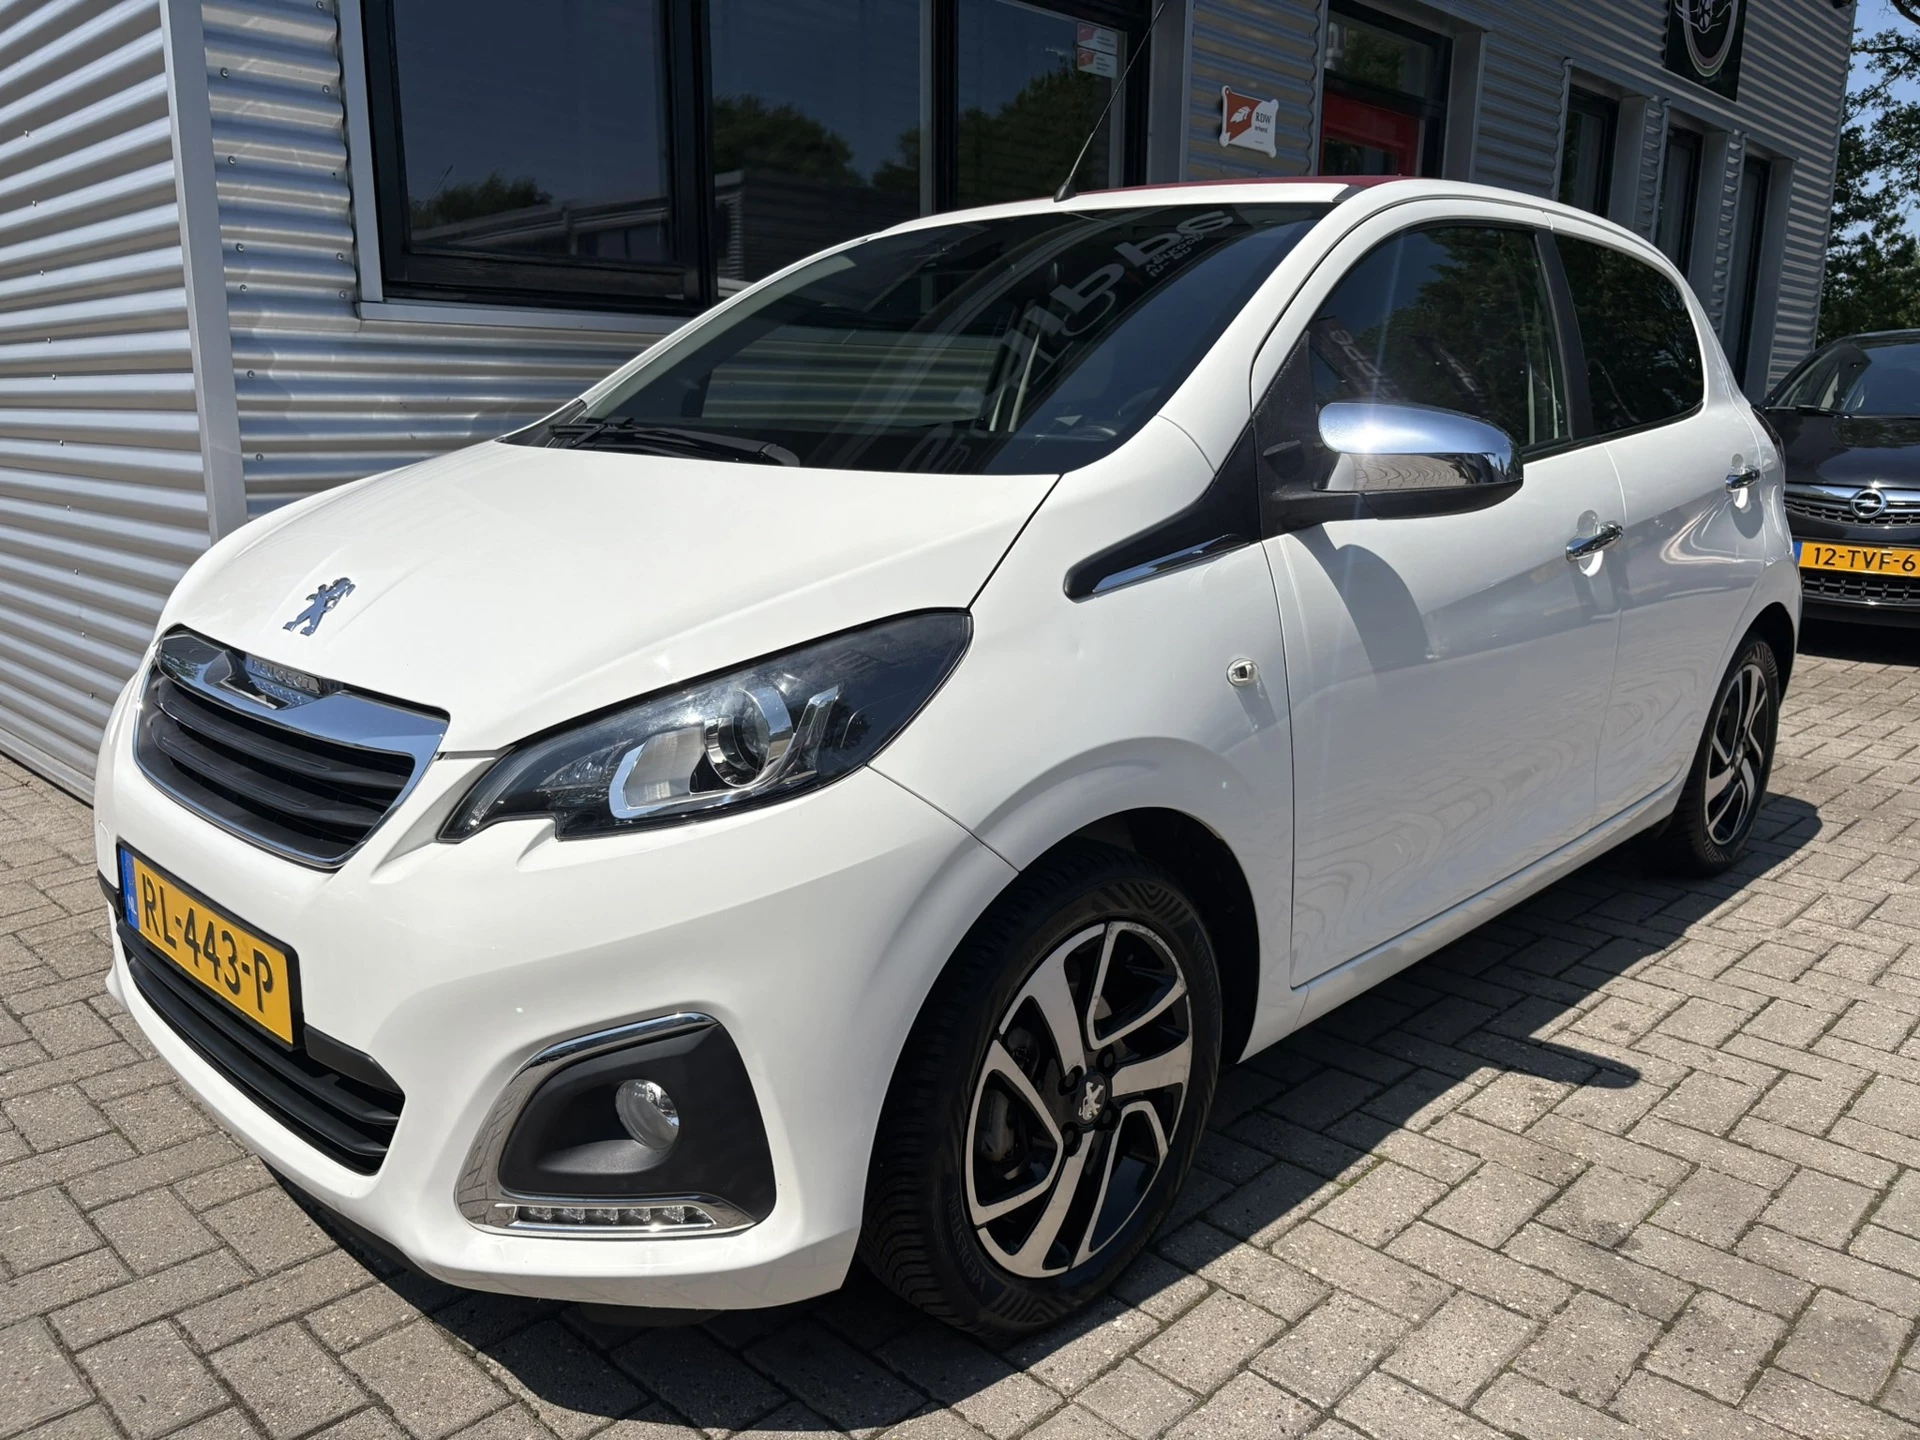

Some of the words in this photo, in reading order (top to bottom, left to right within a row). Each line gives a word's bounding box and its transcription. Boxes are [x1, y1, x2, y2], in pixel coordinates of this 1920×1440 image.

[1255, 112, 1272, 124] RDW
[1814, 547, 1917, 572] 12-TVF-6
[252, 660, 311, 690] PEUGEOT
[141, 873, 274, 1013] RL-443-P
